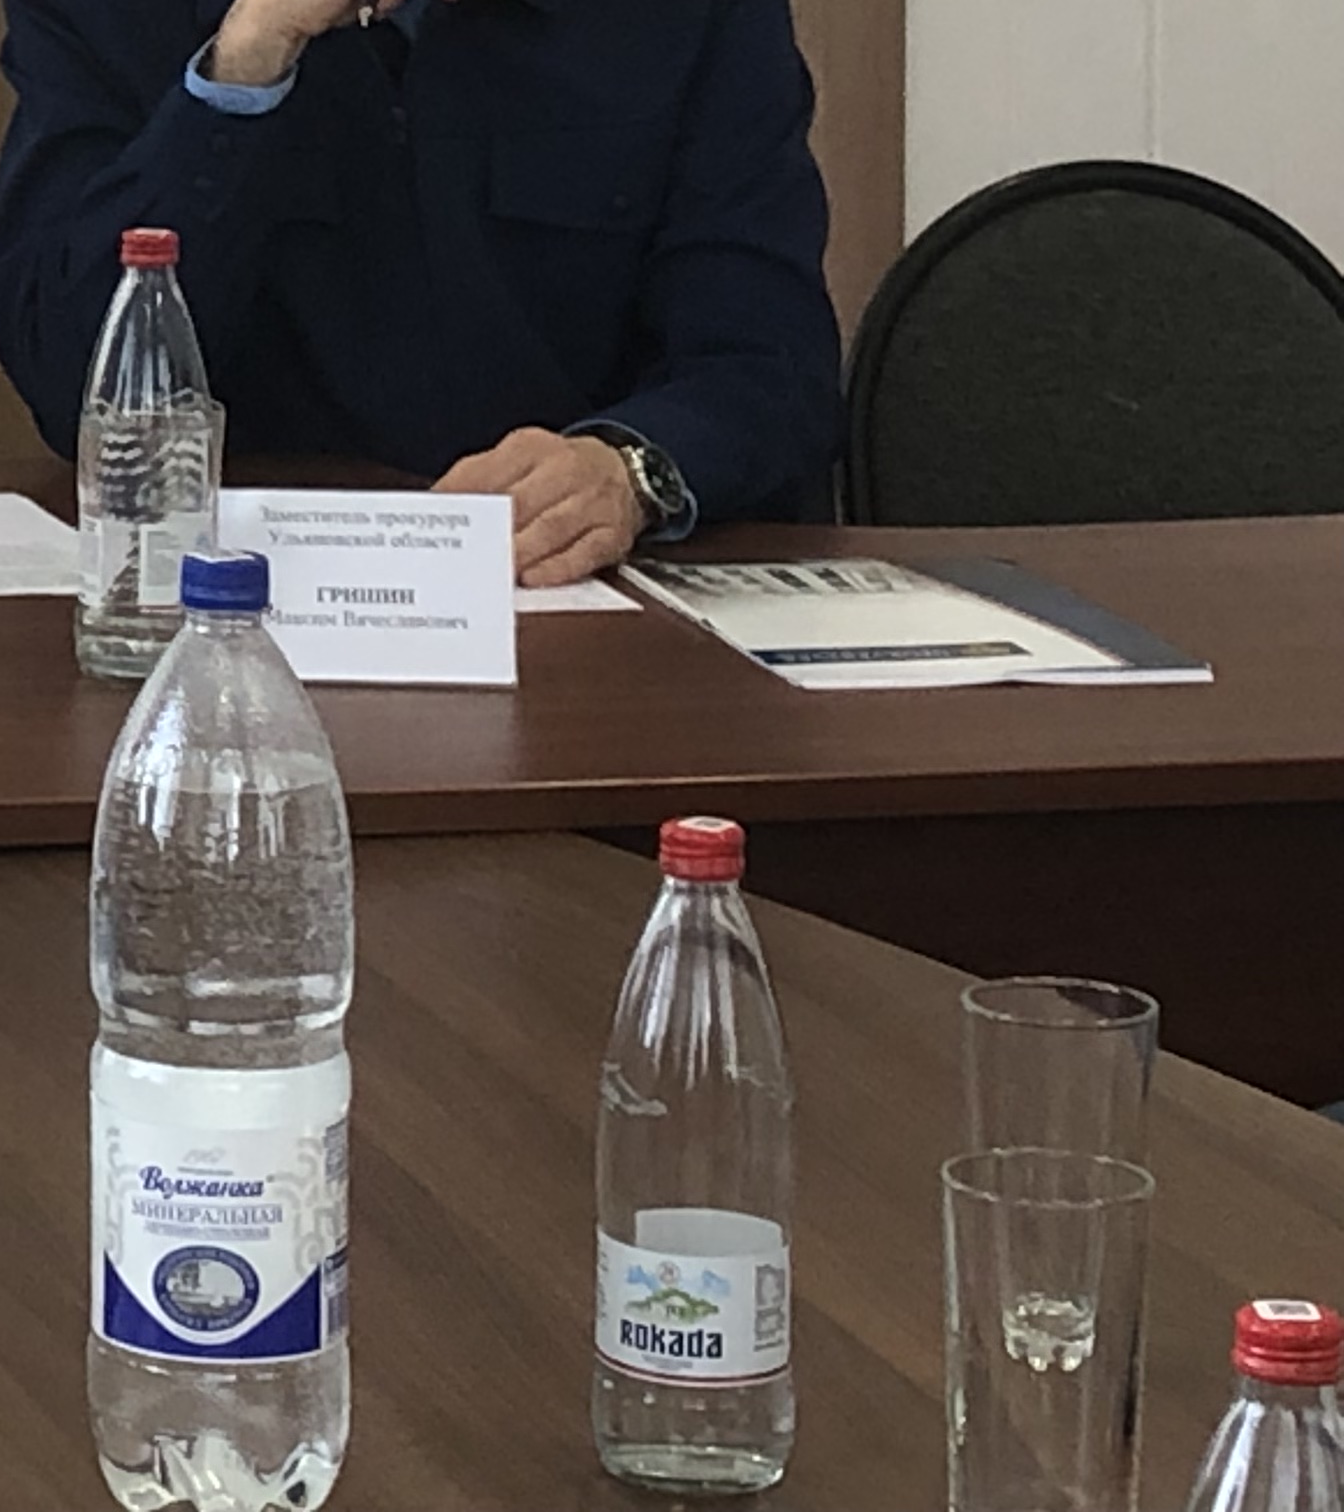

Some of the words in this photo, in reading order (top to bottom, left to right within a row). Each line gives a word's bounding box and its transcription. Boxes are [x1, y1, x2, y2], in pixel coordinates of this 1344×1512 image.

[260, 506, 371, 524] Заместитель
[375, 513, 470, 529] прокурора
[269, 530, 385, 547] Ульяновской
[390, 531, 463, 549] области
[316, 586, 416, 605] ГРИШИН
[343, 610, 468, 630] Вячеславович
[140, 1165, 264, 1199] Волжанка
[131, 1197, 283, 1225] МИНЕРАЛЬНАЯ
